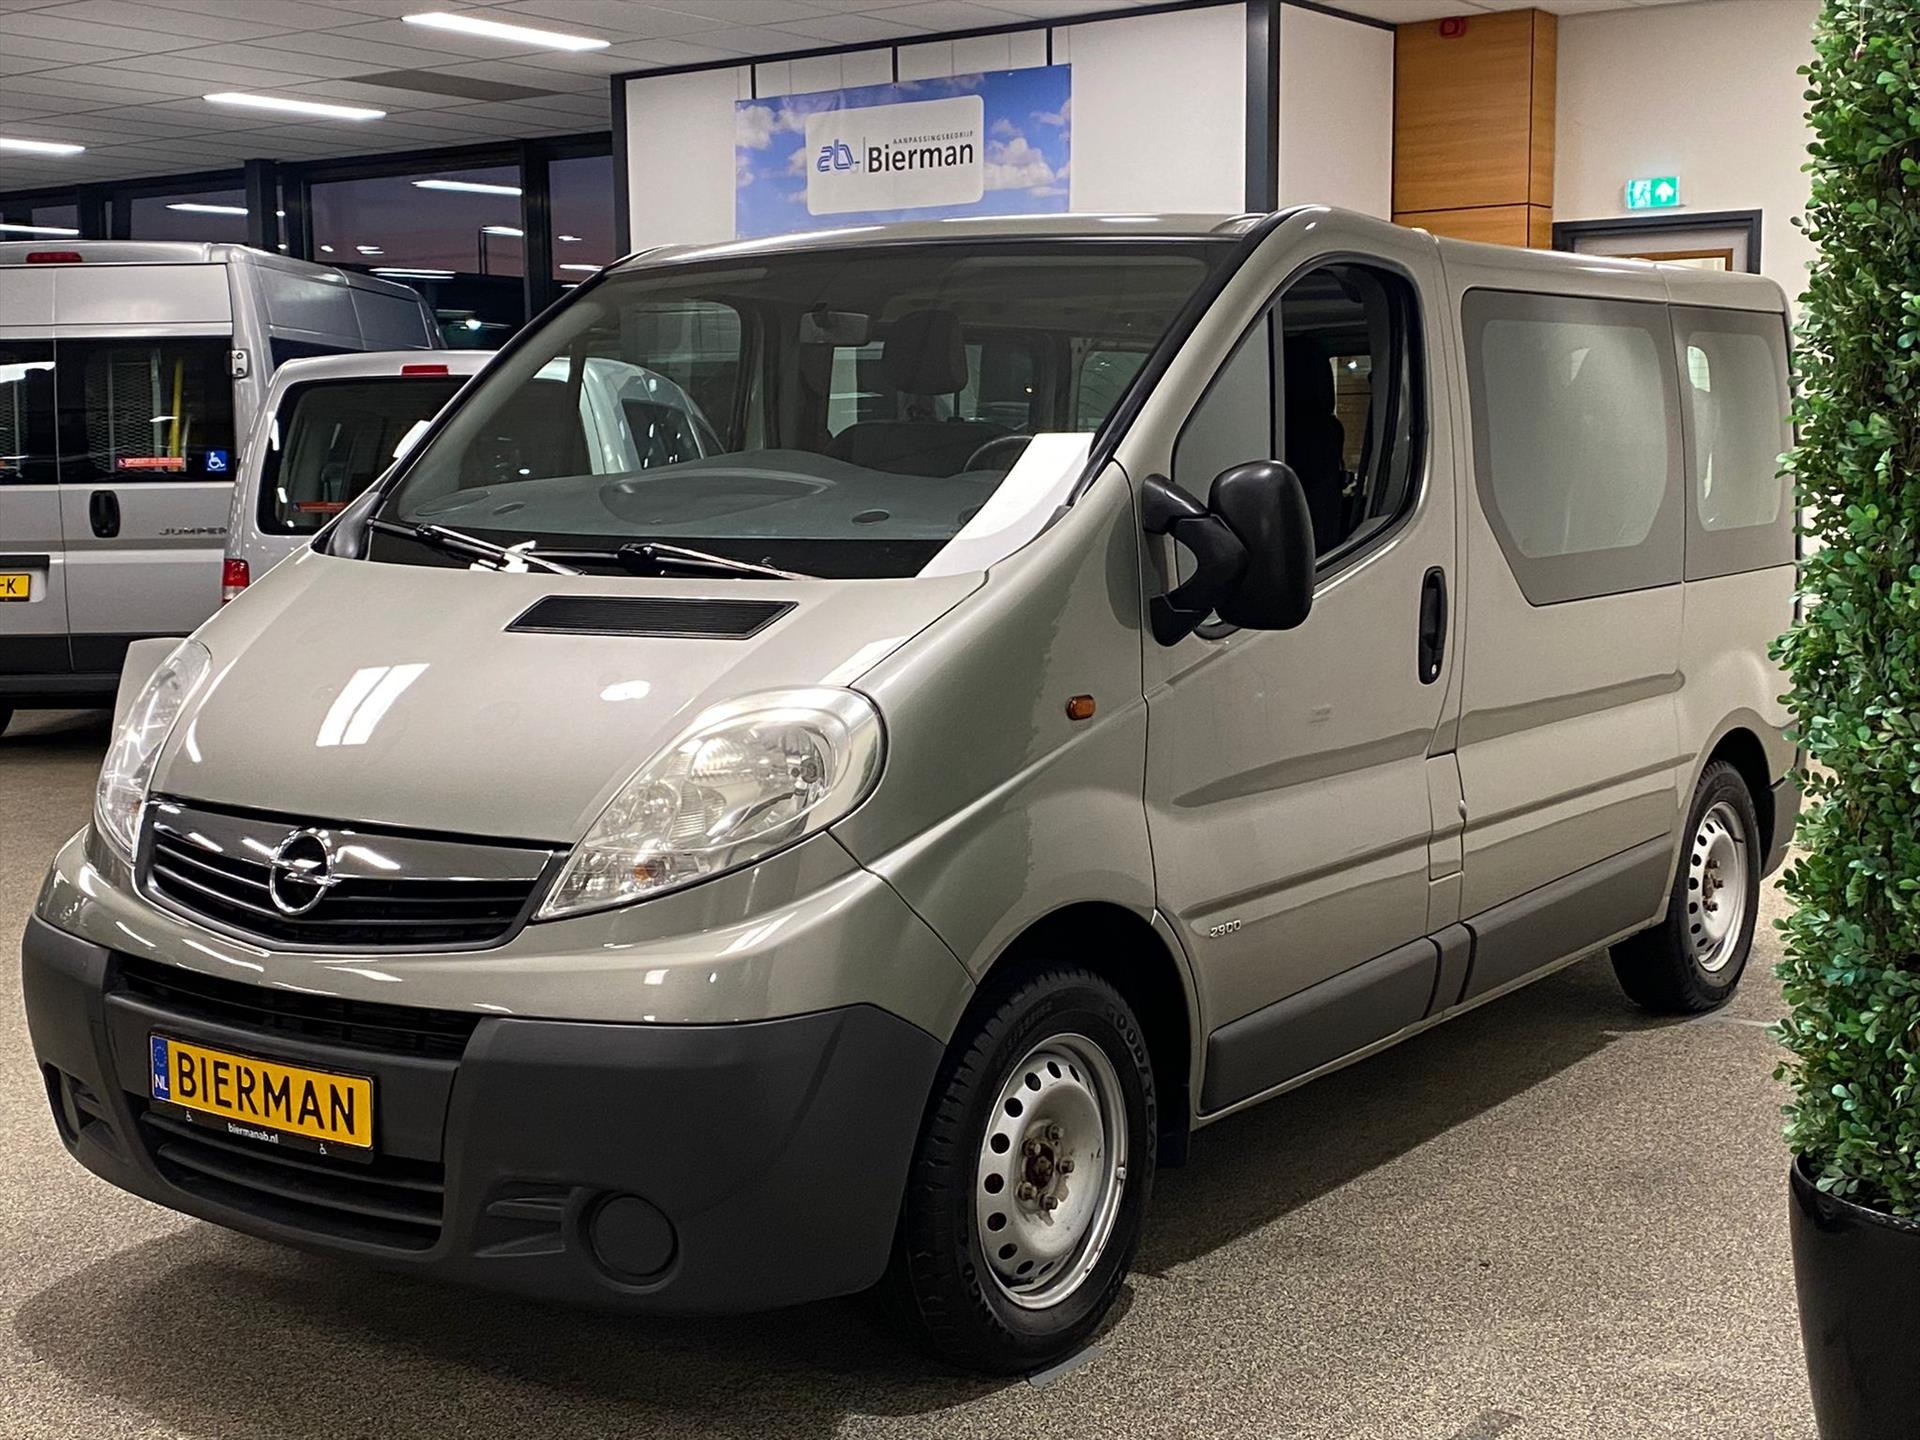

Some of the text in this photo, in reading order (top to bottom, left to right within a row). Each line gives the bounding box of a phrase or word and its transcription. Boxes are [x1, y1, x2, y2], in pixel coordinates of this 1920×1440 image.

[893, 130, 973, 145] AANPASSINGSBEDRIJF
[868, 143, 974, 173] Bierman
[158, 527, 228, 536] JUMPER
[1210, 919, 1242, 938] 2900
[154, 1074, 169, 1091] NL
[176, 1050, 355, 1136] BIERMAN
[227, 1122, 279, 1144] biermanab.nl
